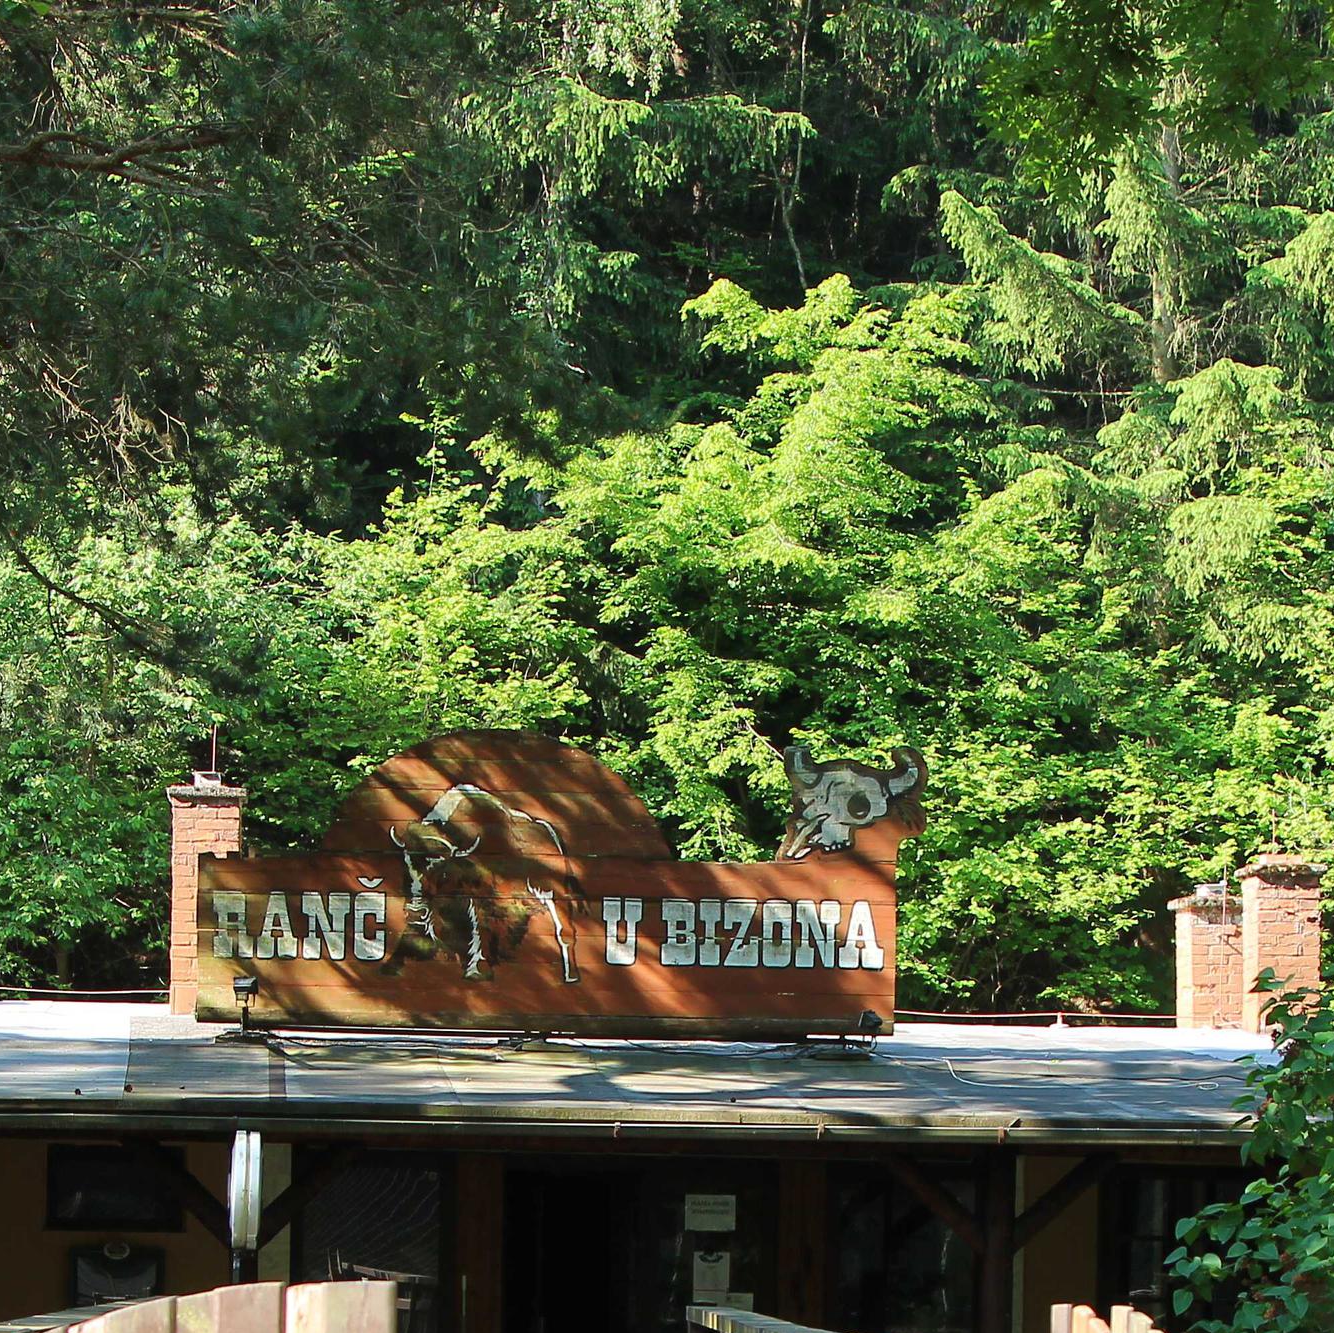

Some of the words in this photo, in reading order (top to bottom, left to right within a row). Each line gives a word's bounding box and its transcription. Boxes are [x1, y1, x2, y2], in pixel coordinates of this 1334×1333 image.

[212, 876, 387, 961] RANČ
[602, 896, 644, 966] U
[660, 897, 885, 970] BIZONA
